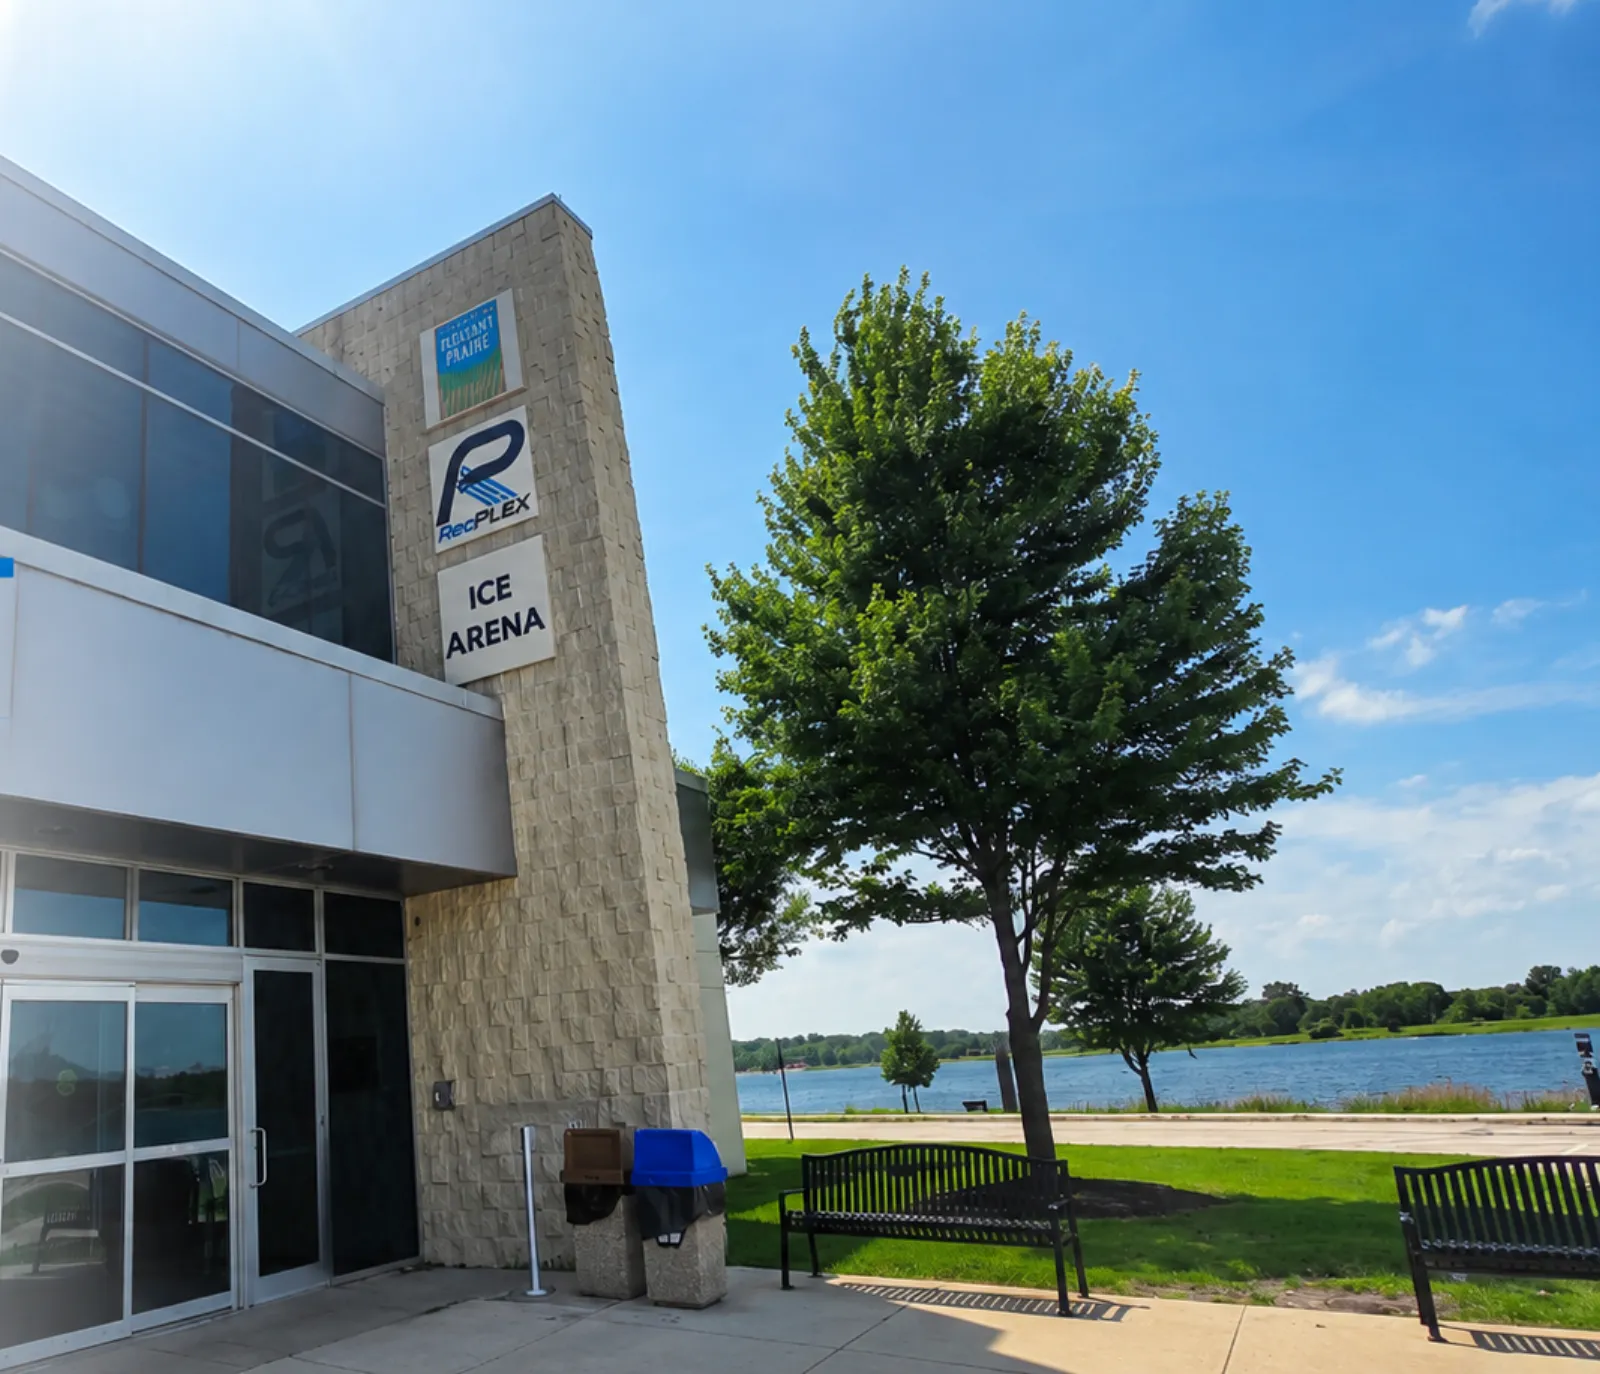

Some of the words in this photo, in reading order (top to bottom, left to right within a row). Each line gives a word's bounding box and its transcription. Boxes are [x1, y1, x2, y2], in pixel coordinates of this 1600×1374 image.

[438, 492, 531, 544] RecPLEX
[469, 574, 512, 610] ICE
[446, 607, 546, 660] ARENA
